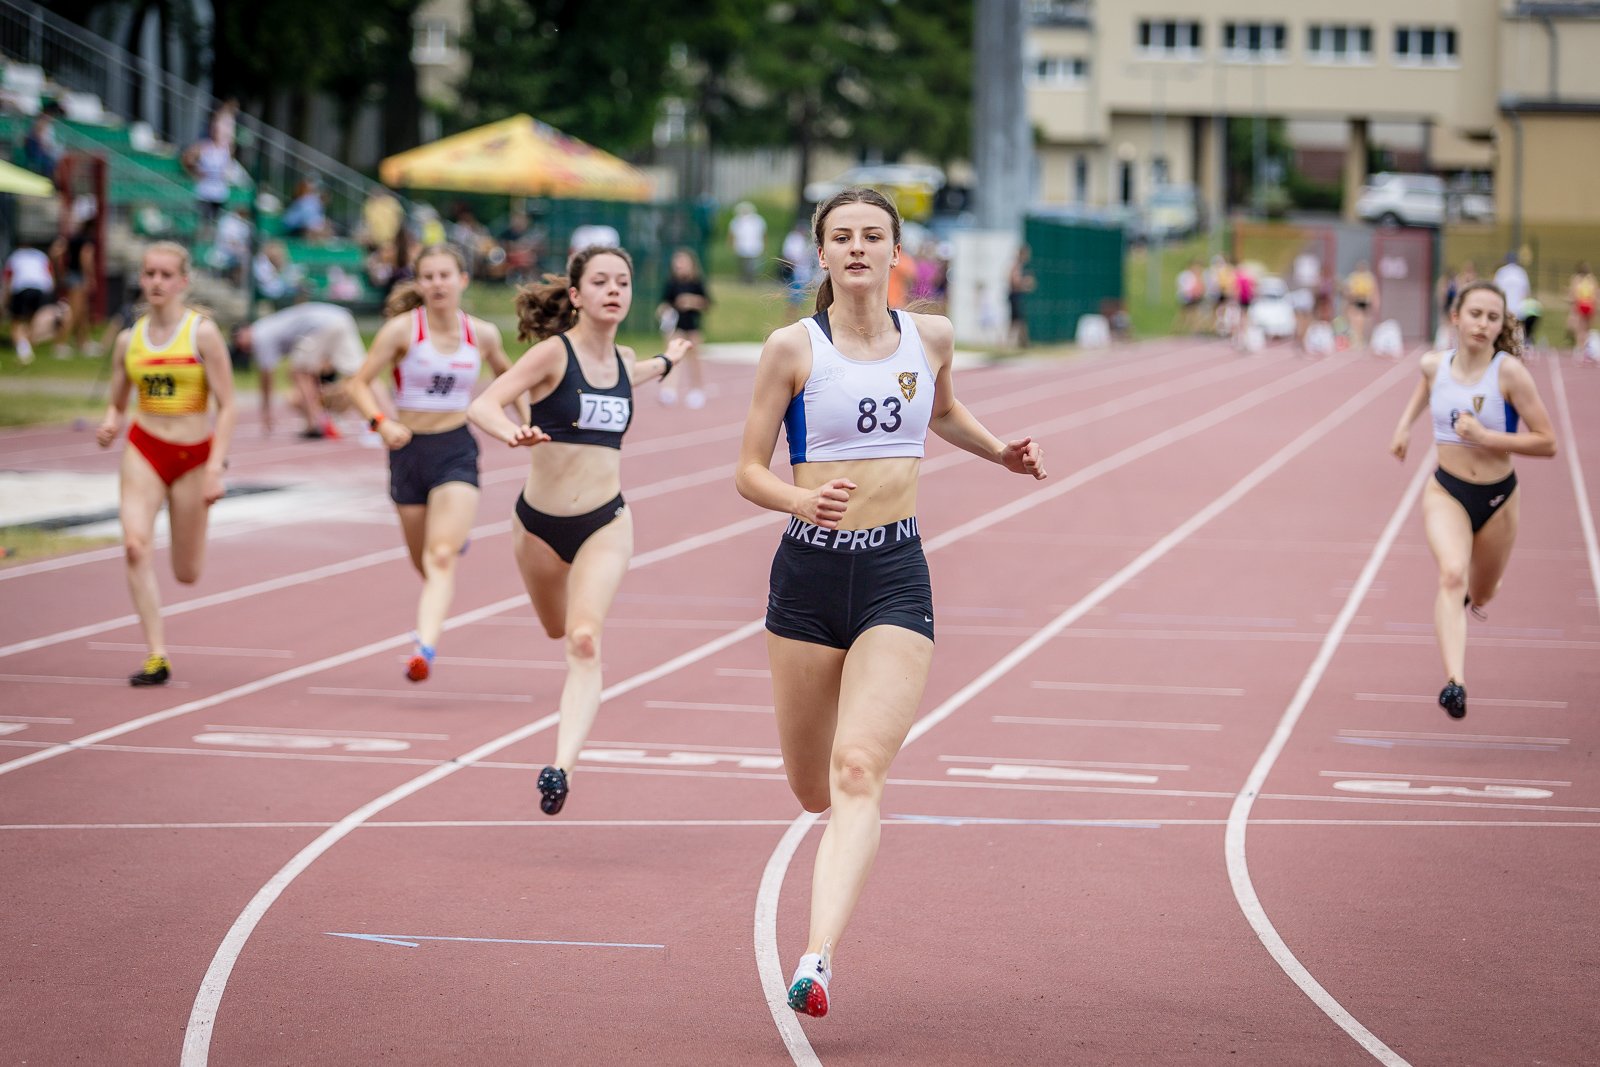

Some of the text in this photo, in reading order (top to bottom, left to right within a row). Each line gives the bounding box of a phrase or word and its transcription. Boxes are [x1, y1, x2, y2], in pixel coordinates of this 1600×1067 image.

[585, 400, 626, 424] 753
[857, 396, 902, 434] 83
[786, 515, 832, 547] NIKE
[832, 529, 886, 550] PRO
